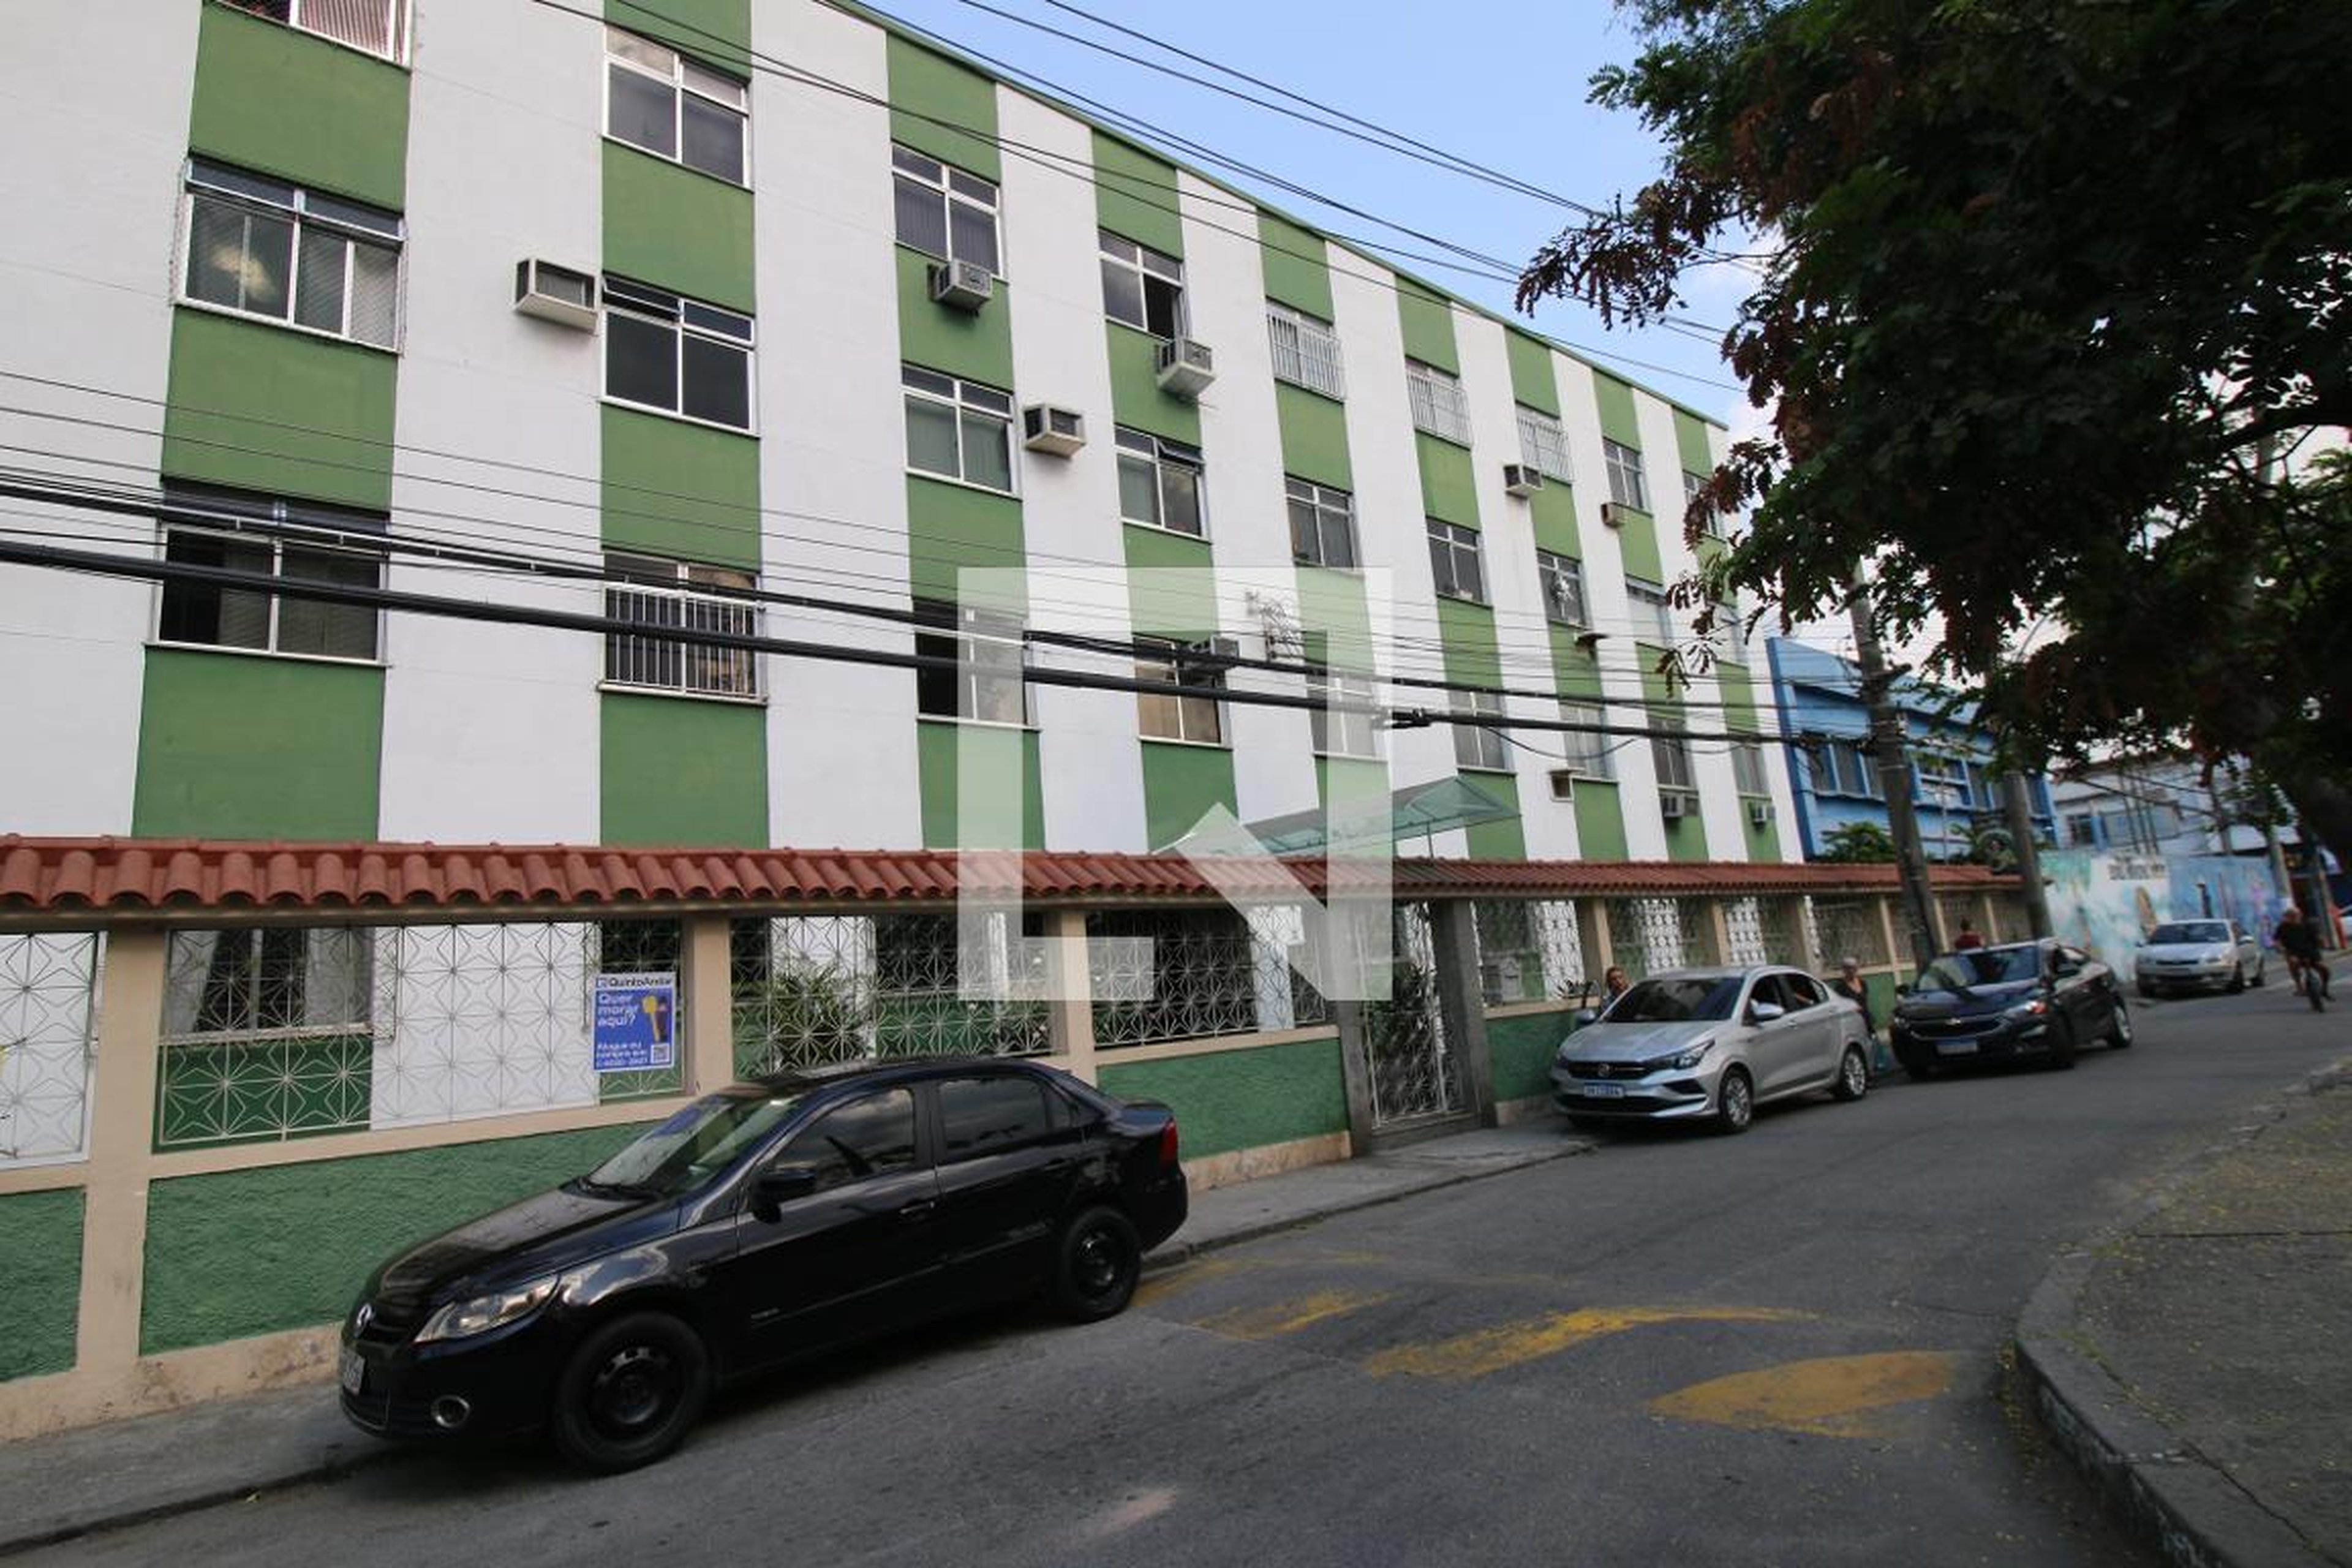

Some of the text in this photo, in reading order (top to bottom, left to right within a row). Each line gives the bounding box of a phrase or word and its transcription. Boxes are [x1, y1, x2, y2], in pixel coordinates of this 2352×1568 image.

[598, 993, 632, 1005] Quer
[598, 1003, 639, 1016] morar
[598, 1012, 636, 1028] aqui?
